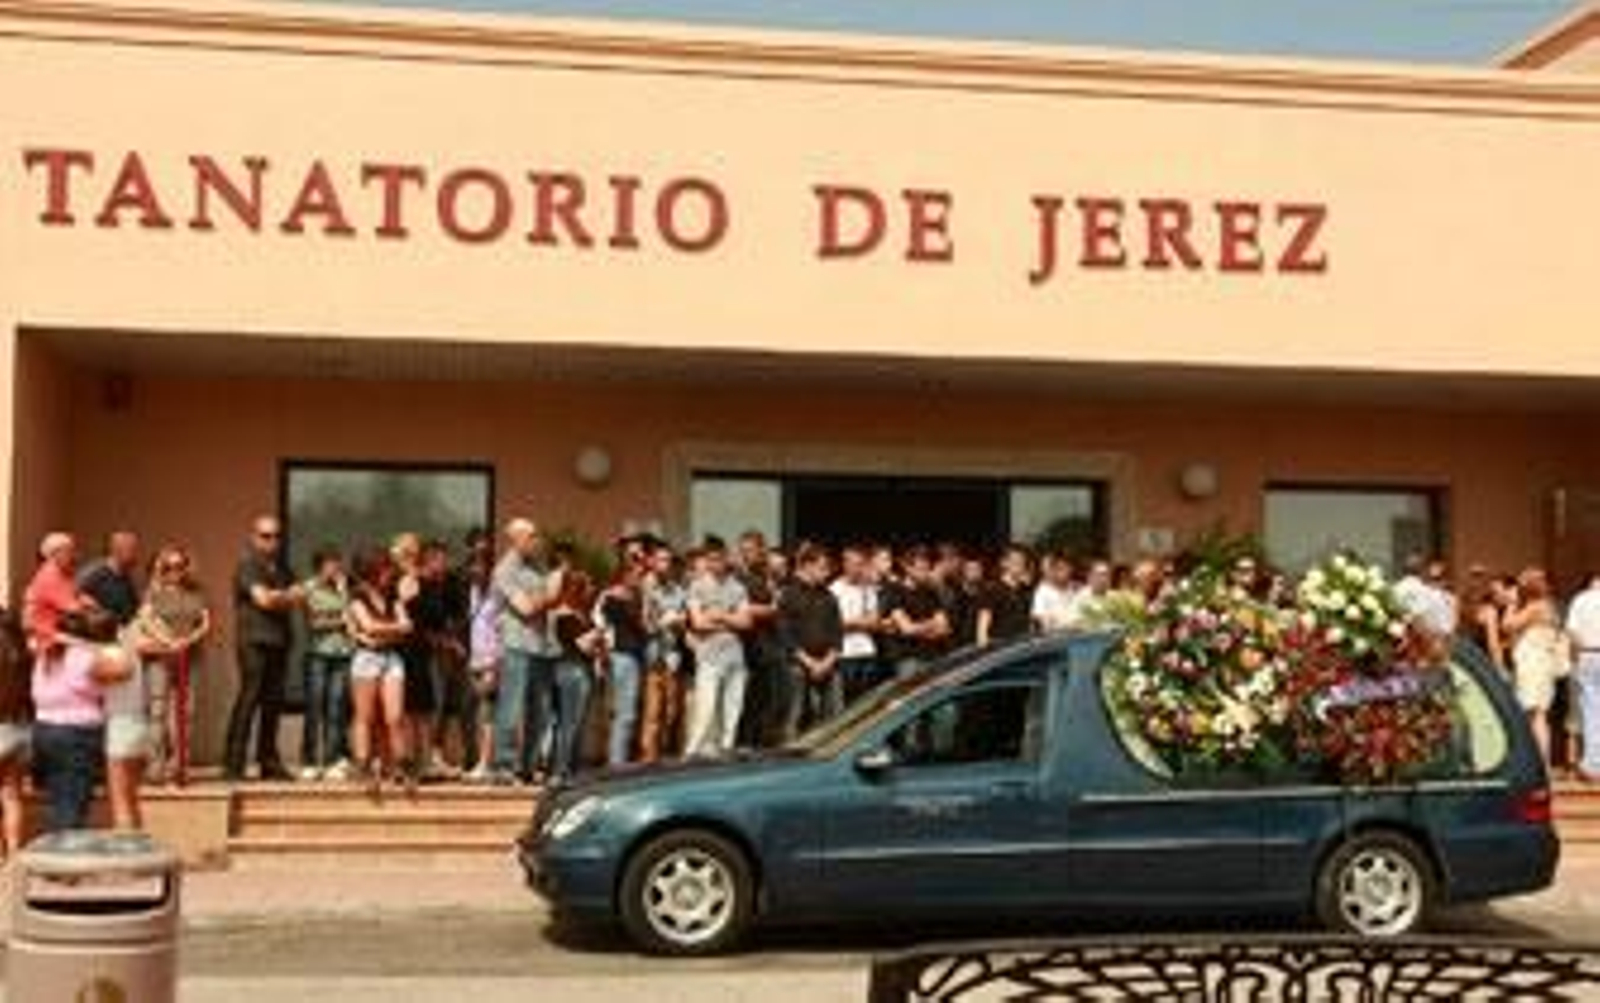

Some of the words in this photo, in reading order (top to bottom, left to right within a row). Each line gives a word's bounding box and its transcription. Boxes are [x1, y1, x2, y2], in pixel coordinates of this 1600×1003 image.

[22, 150, 729, 252] TANATORIO
[812, 185, 954, 262] DE
[1028, 196, 1328, 285] JEREZ
